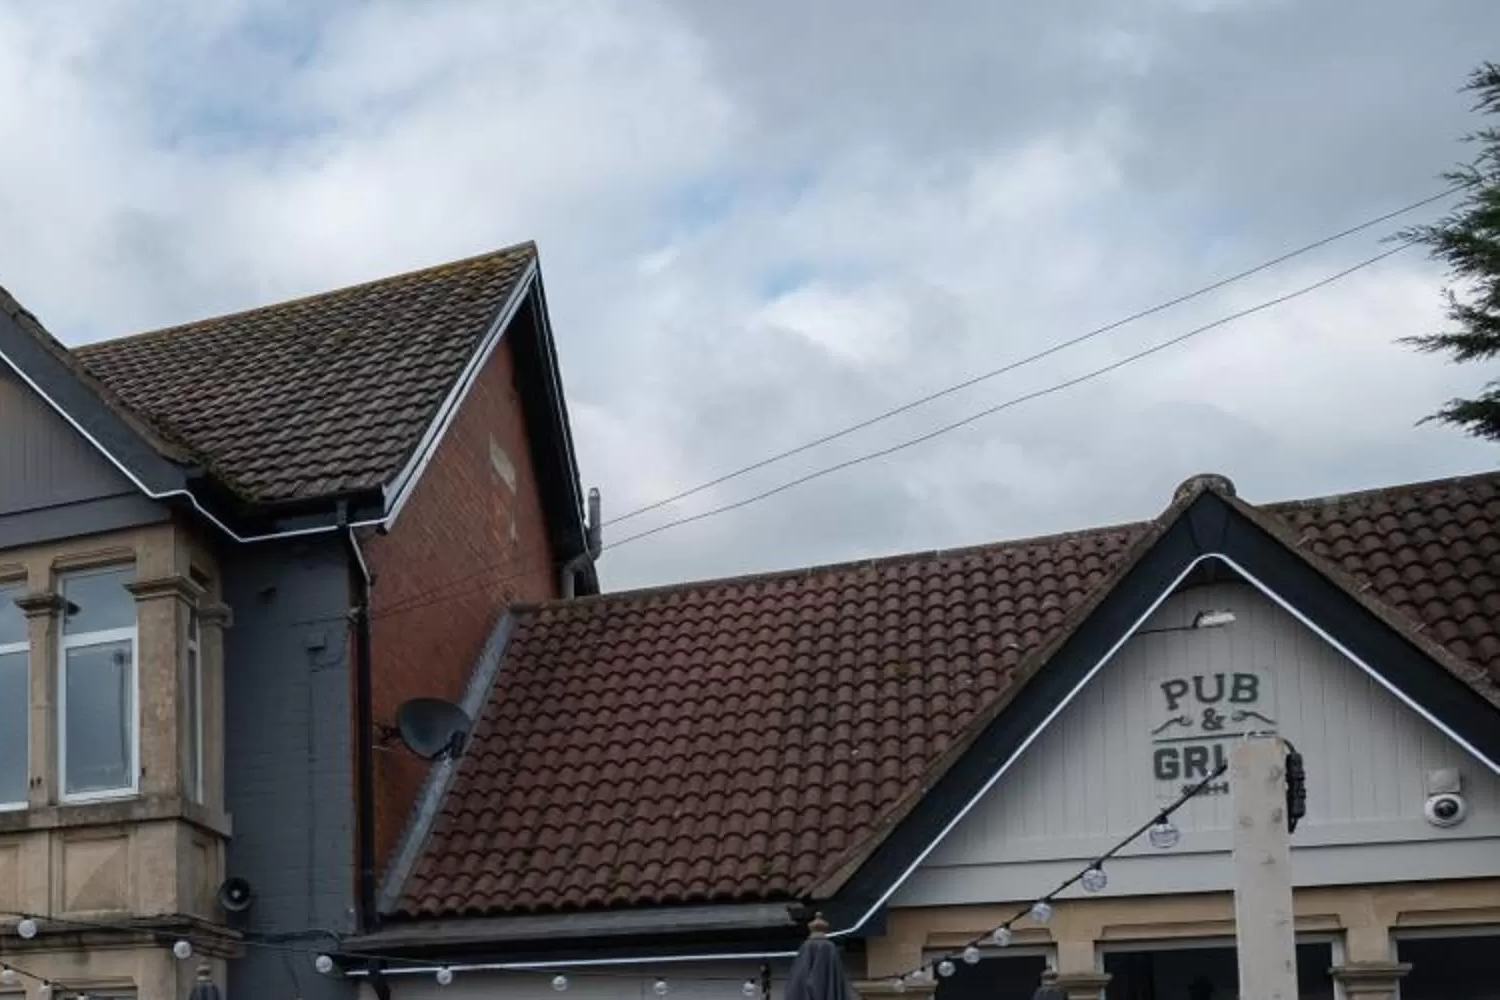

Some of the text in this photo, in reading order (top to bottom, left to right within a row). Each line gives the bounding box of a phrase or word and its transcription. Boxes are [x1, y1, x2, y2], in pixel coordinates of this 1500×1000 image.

[1160, 672, 1260, 711] PUB
[1201, 707, 1226, 731] &
[1153, 743, 1225, 780] GRI
